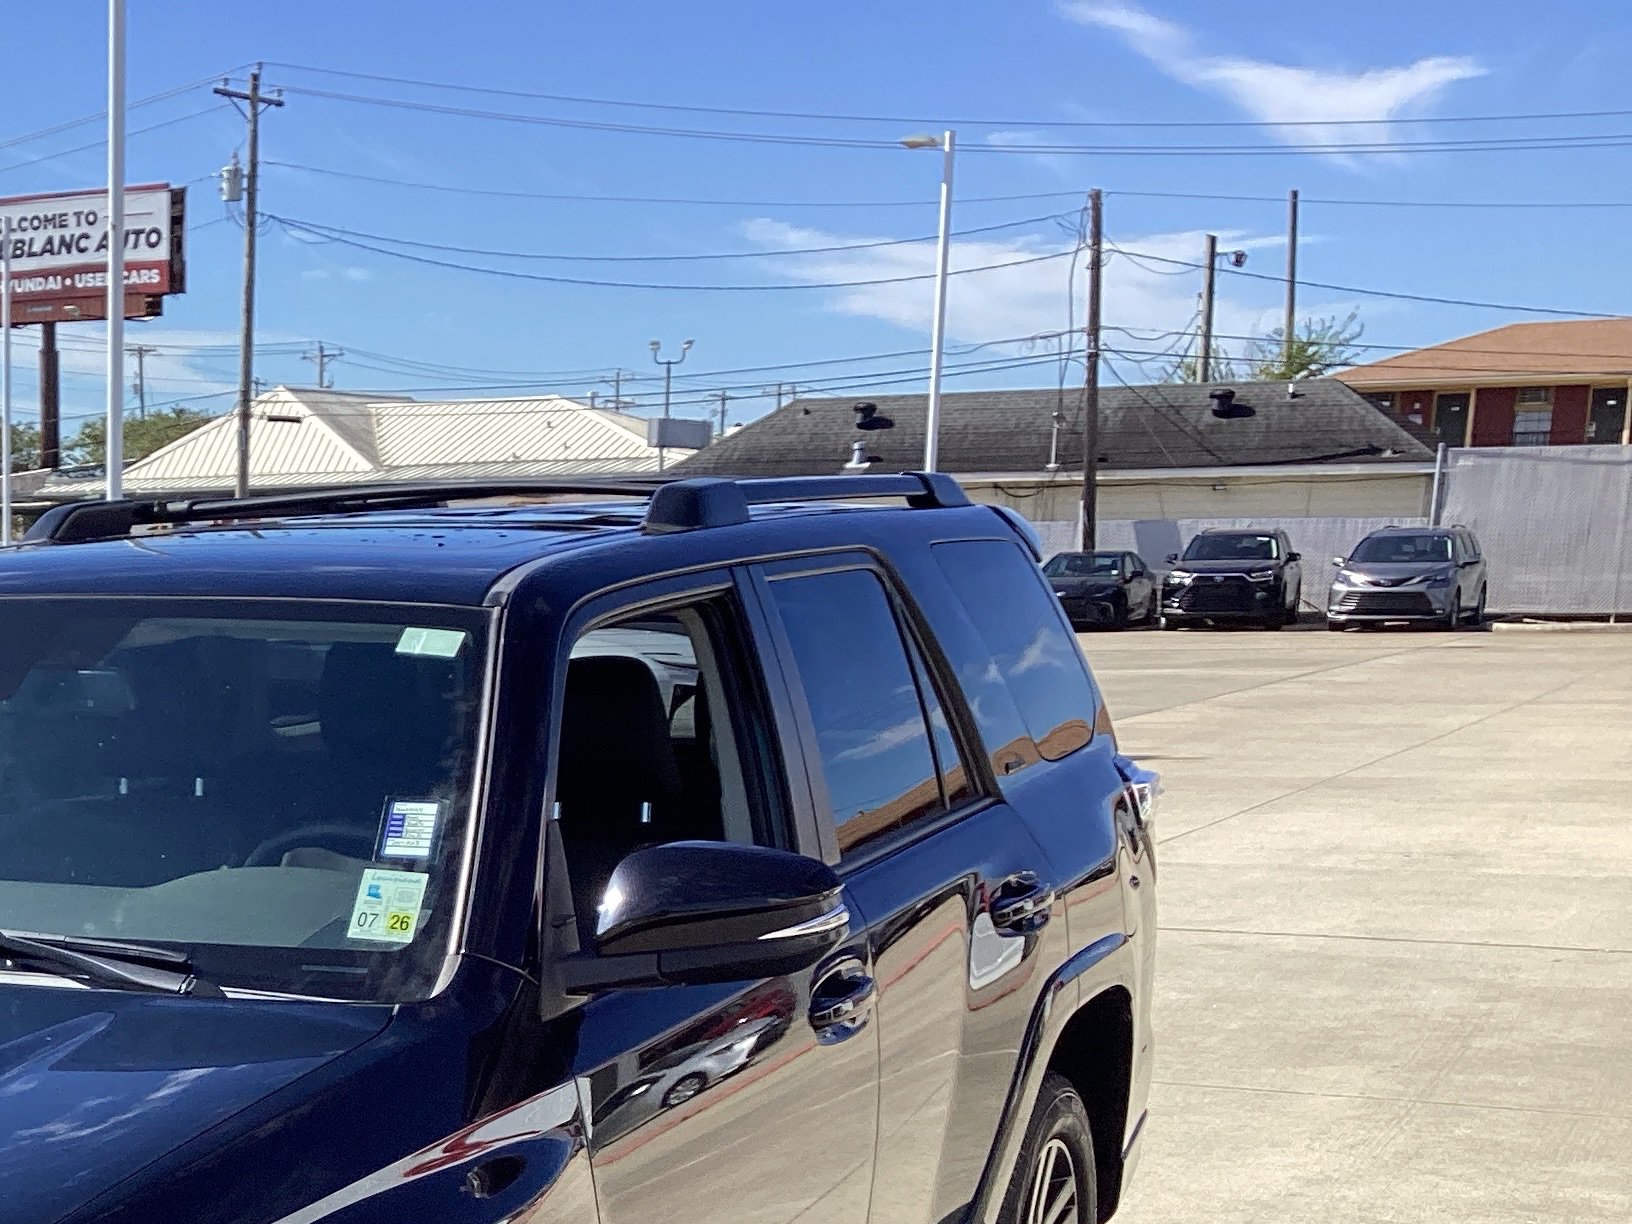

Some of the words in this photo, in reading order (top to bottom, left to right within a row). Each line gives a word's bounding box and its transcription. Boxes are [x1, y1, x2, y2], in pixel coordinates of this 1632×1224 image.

[72, 210, 97, 227] TO
[73, 271, 110, 288] USE
[357, 911, 380, 929] 07
[389, 914, 411, 931] 26
